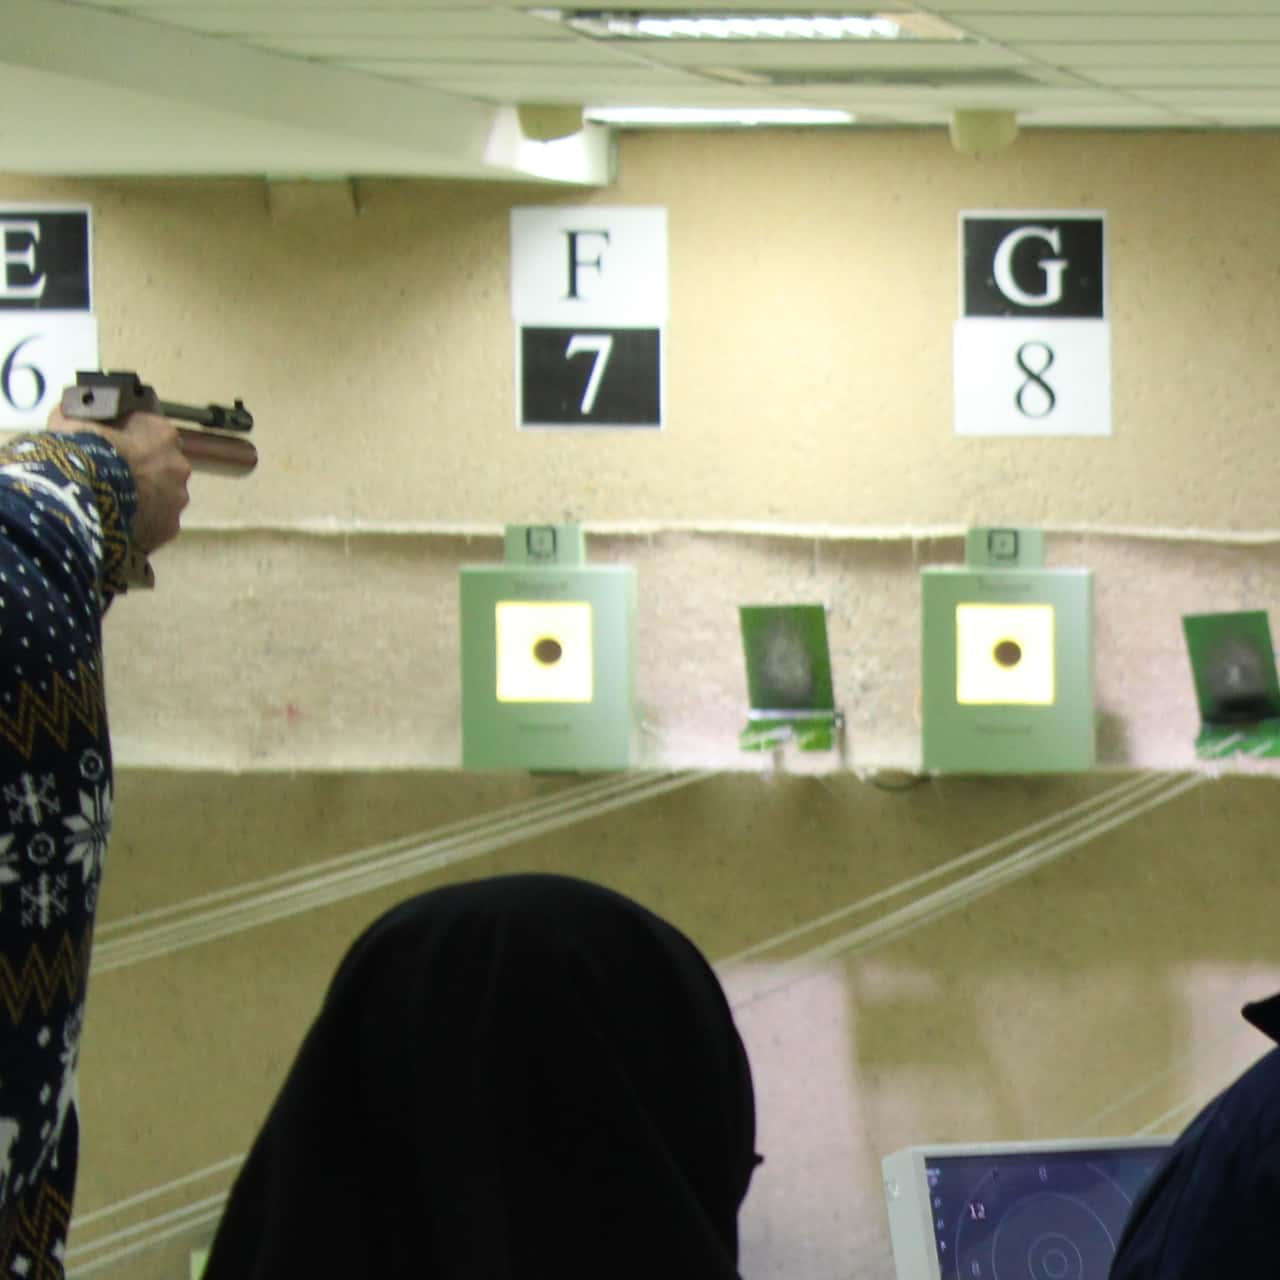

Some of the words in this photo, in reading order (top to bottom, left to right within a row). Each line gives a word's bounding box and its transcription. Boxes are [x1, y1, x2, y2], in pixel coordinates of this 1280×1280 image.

[0, 220, 46, 300] E
[564, 229, 610, 300] F
[992, 226, 1067, 307] G
[1, 337, 46, 412] 6
[564, 334, 614, 415] 7
[1014, 342, 1057, 418] 8
